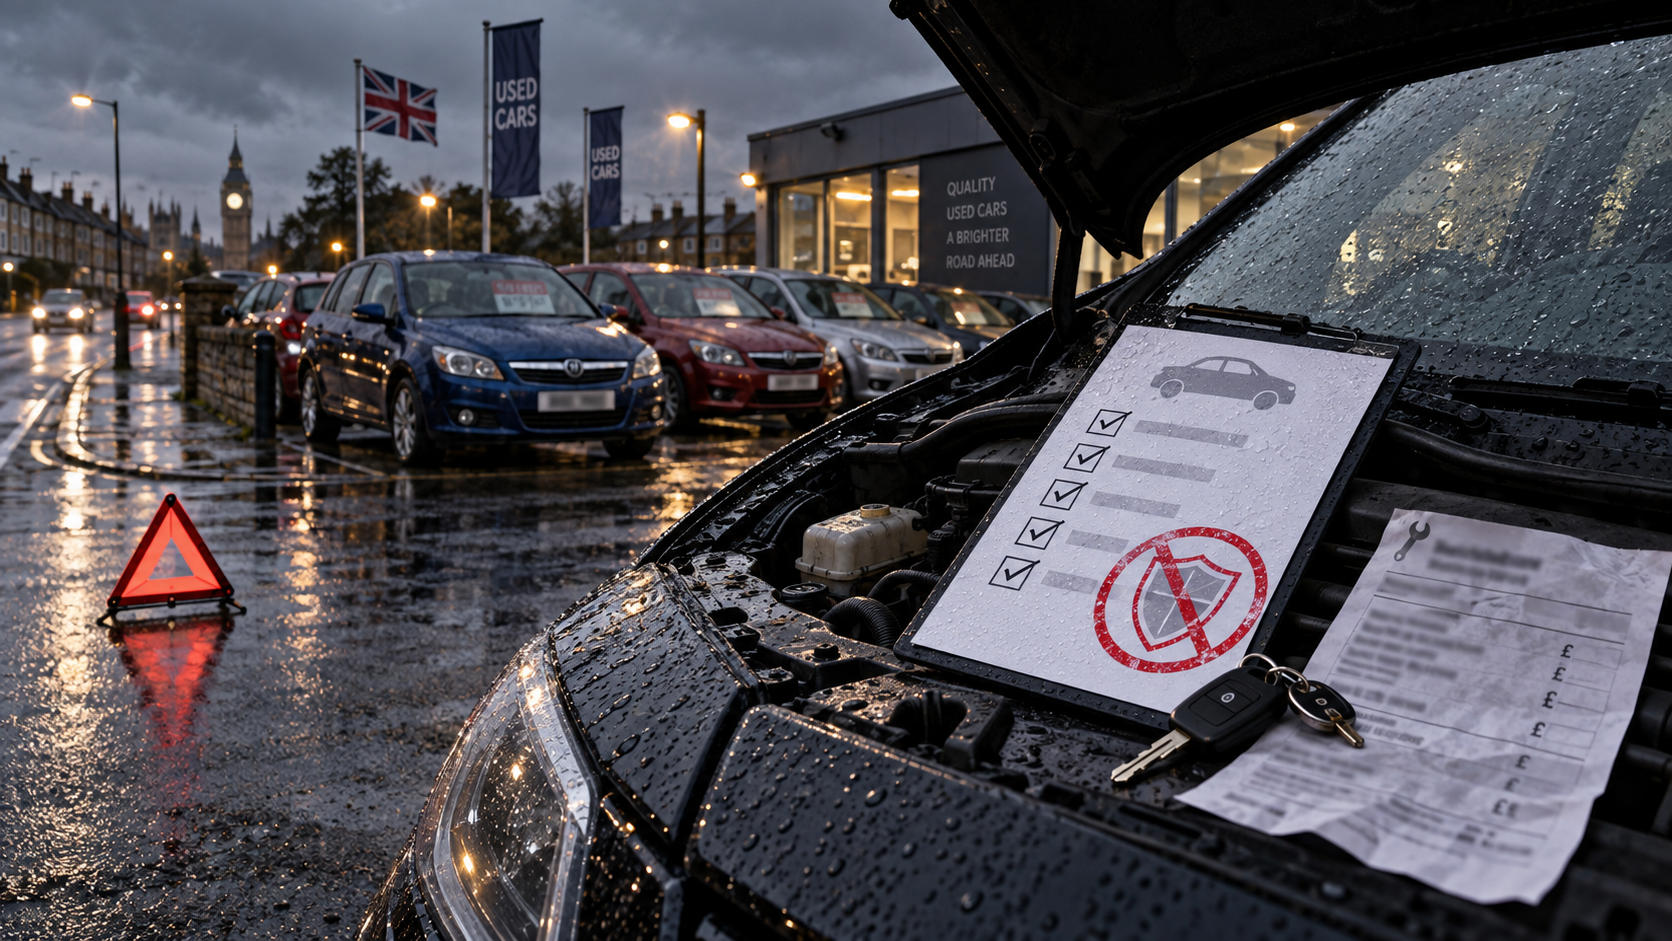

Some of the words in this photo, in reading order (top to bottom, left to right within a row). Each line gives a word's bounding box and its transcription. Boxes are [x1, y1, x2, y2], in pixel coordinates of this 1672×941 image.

[496, 77, 537, 103] USED
[495, 104, 537, 130] CARS
[592, 145, 620, 162] USED
[591, 163, 620, 180] CARS
[947, 176, 996, 196] QUALITY
[947, 204, 975, 220] USED
[977, 201, 1007, 217] CARS
[946, 231, 954, 245] A
[956, 227, 1009, 244] BRIGHTER
[946, 255, 975, 269] ROAD
[977, 253, 1015, 268] AHEAD
[1560, 644, 1574, 659] £
[1551, 666, 1567, 682] £
[1542, 691, 1558, 709] £
[1530, 721, 1546, 738] £
[1515, 755, 1531, 770] £
